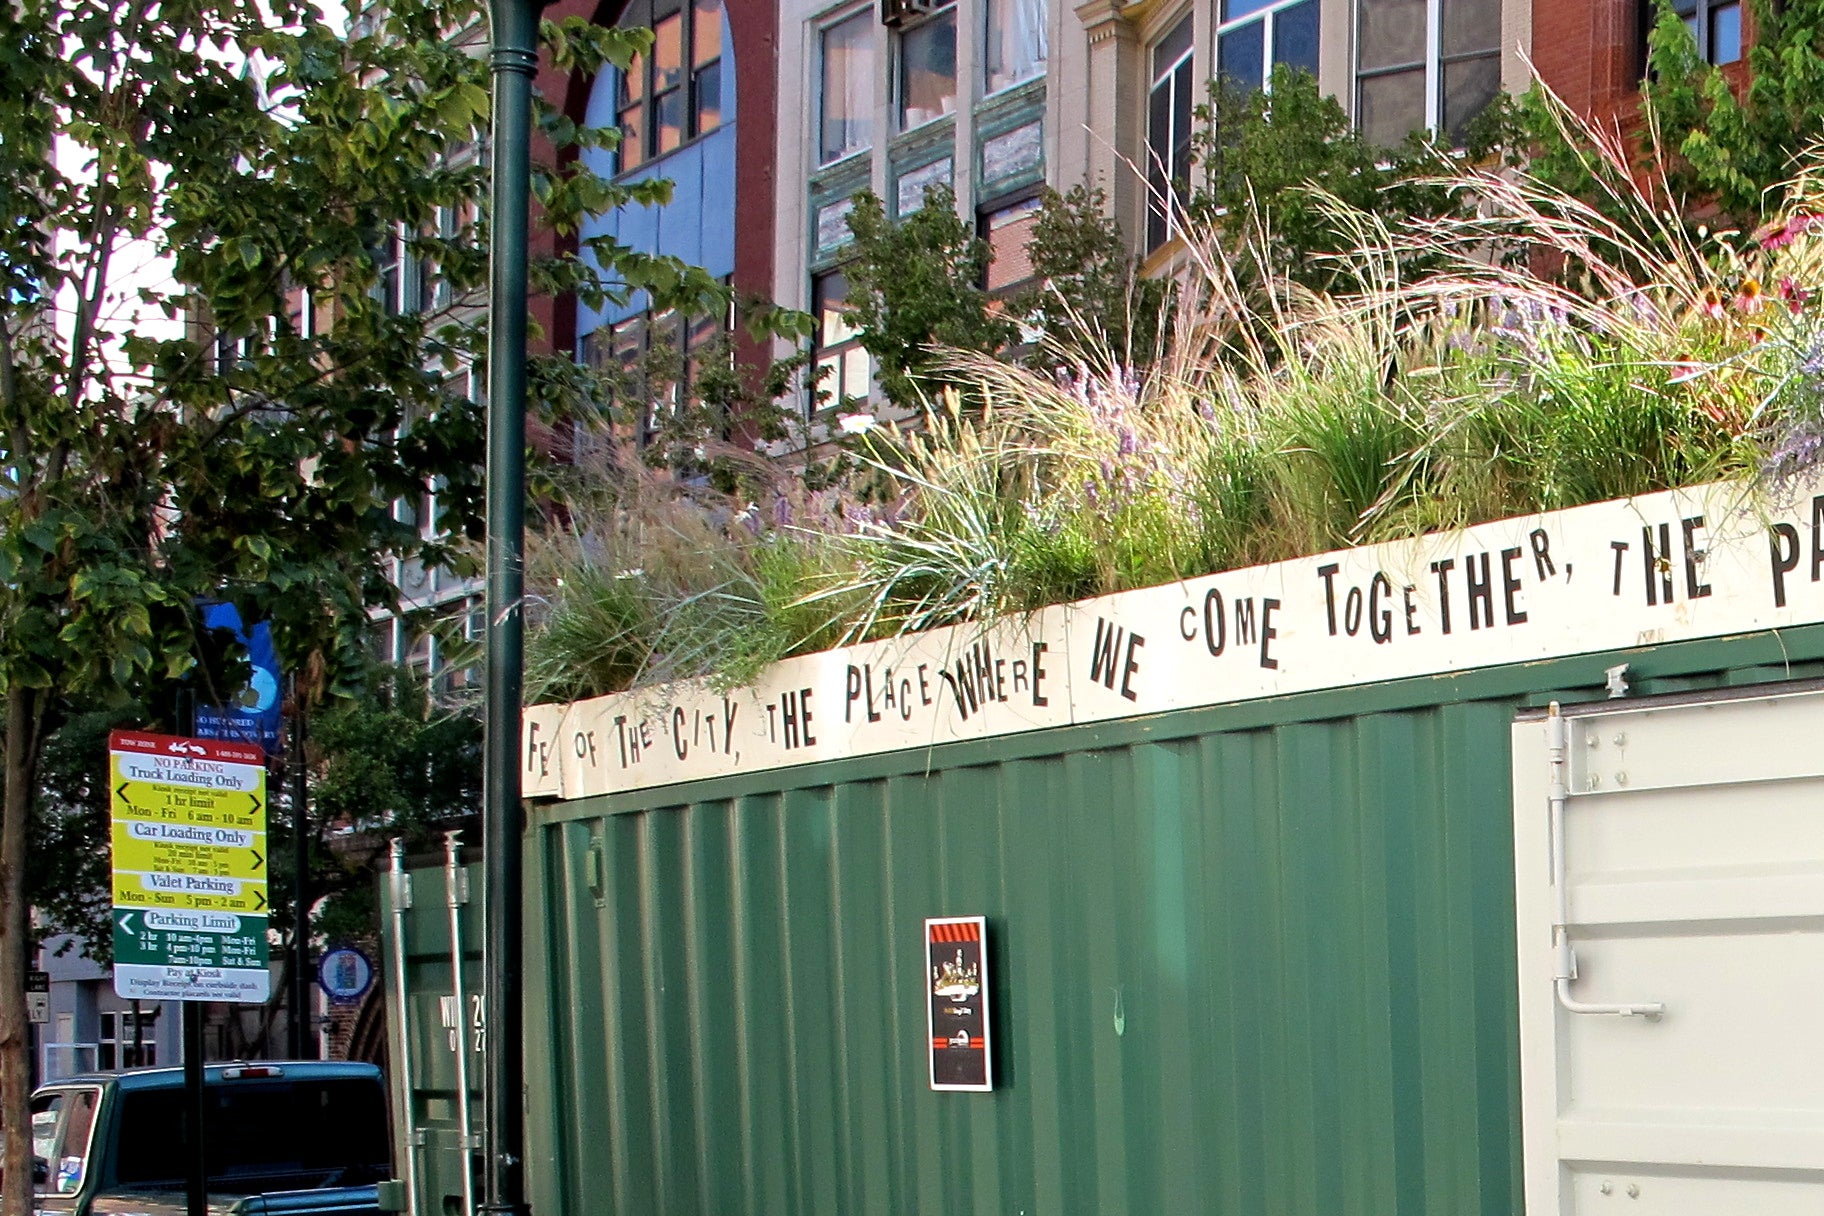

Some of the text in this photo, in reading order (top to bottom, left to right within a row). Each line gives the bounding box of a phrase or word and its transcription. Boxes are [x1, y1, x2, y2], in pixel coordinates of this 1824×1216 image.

[575, 730, 597, 768] OF
[614, 713, 654, 770] THE
[672, 698, 741, 767] CITY,
[766, 687, 816, 751] THE
[845, 662, 932, 725] PLACE
[938, 638, 1049, 722] WHERE
[1090, 616, 1145, 703] WE
[1180, 587, 1281, 671] COME
[1317, 526, 1574, 645] TOGETHER,
[1610, 515, 1713, 607] THE
[154, 758, 223, 773] NO PARKING
[130, 766, 243, 790] Truck Loading Only
[166, 795, 214, 808] 1 hr limit
[127, 805, 151, 816] Mon
[161, 808, 176, 819] Fri
[188, 811, 194, 820] 6
[196, 813, 212, 822] am
[223, 814, 234, 824] 10
[237, 817, 253, 825] am
[135, 823, 246, 846] Car Loading Only
[151, 875, 234, 894] Valet Parking
[120, 890, 145, 902] Mon
[155, 893, 175, 904] Sun
[186, 895, 192, 905] 5
[195, 897, 212, 908] pm
[221, 897, 228, 906] 2
[230, 900, 246, 908] am
[151, 912, 236, 930] Parking Limit
[140, 932, 146, 940] 2
[148, 932, 158, 941] hr
[148, 942, 158, 951] hr
[222, 957, 236, 966] Sat
[245, 958, 261, 967] Sun
[167, 968, 182, 978] Pay
[197, 969, 222, 978] Kiosk
